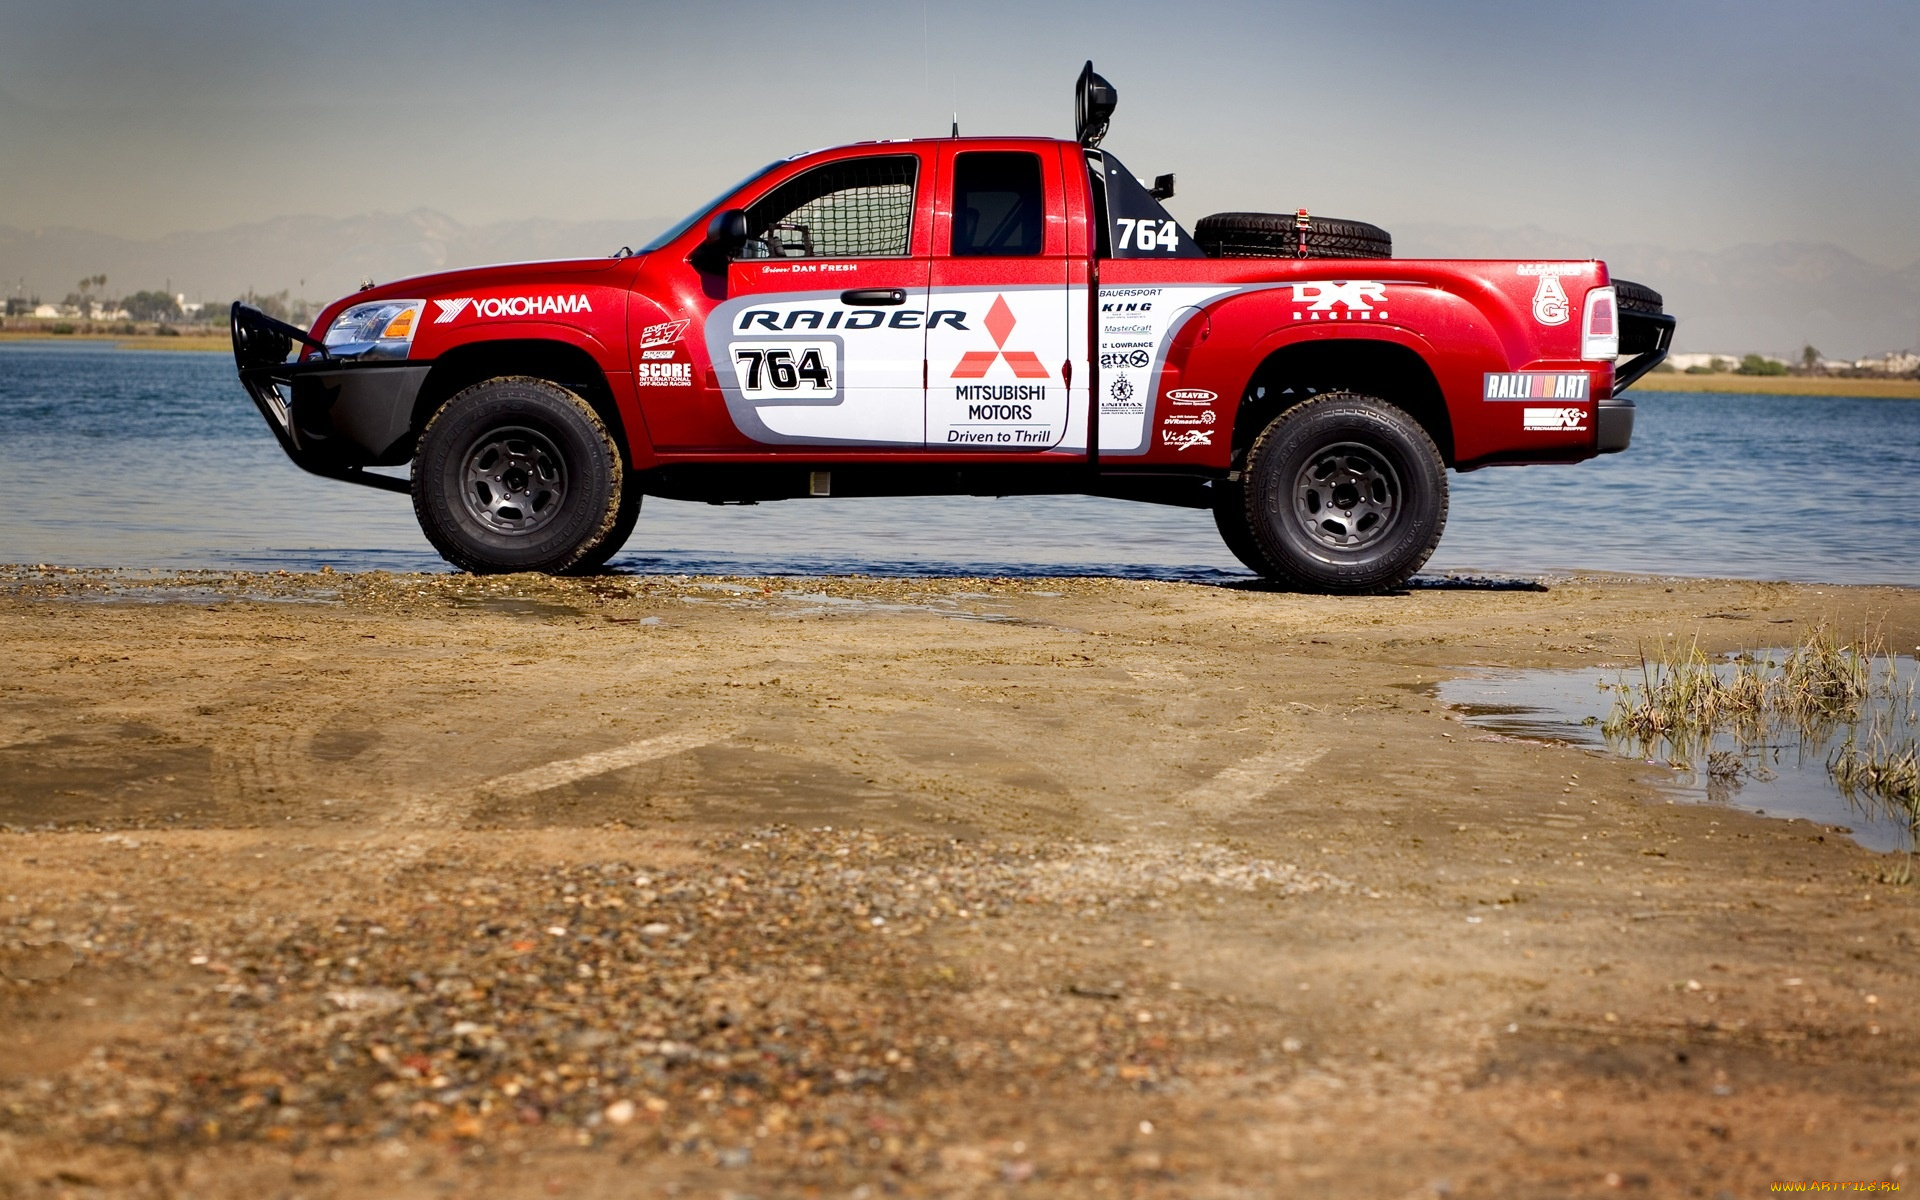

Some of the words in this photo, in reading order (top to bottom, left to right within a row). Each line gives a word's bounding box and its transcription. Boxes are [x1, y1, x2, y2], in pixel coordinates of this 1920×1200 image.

[1117, 218, 1179, 252] 764
[792, 264, 817, 273] DAN
[820, 263, 858, 272] FRESH
[1099, 288, 1163, 297] BAUERSPORT
[472, 295, 592, 318] YOKOHAMA
[1102, 302, 1152, 312] KING
[738, 310, 970, 331] RAIDER
[1292, 311, 1389, 320] RACING
[1111, 341, 1154, 349] LOWRANCE
[639, 363, 692, 378] SCORE
[735, 348, 833, 392] 764
[955, 385, 1046, 401] MITSUBISHI
[968, 404, 1033, 420] MOTORS
[947, 430, 994, 443] Driven
[997, 431, 1012, 443] to
[1015, 430, 1052, 443] Thrill
